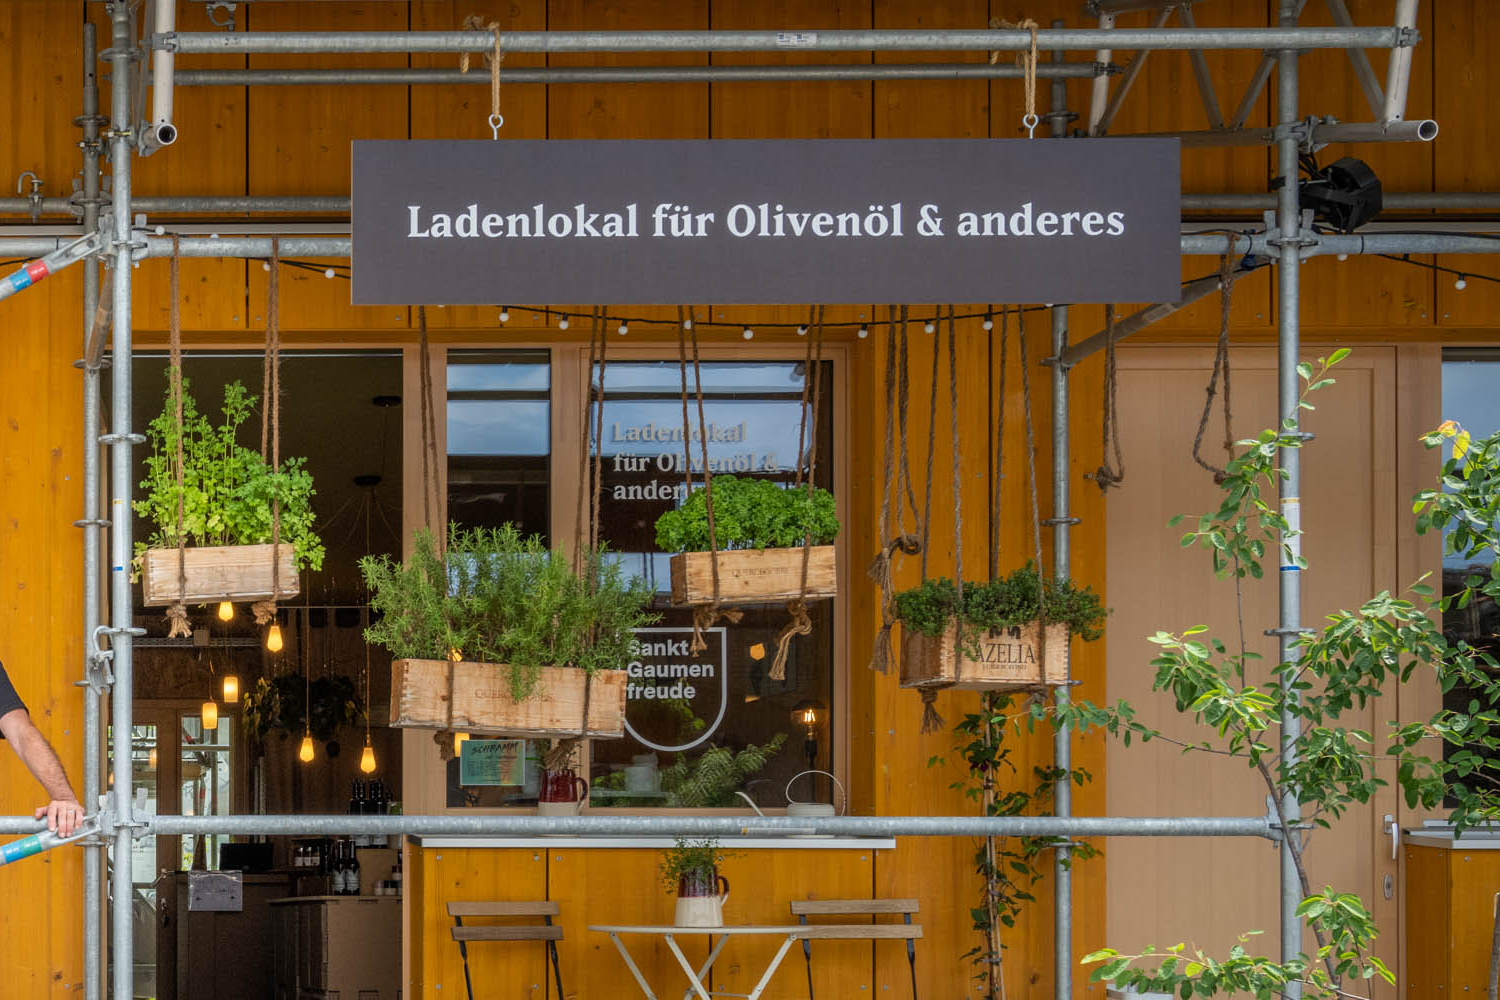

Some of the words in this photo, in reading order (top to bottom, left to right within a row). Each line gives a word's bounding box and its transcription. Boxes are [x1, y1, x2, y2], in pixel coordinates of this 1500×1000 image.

[407, 203, 639, 238] Ladenlokal
[652, 203, 715, 238] für
[726, 203, 904, 238] Olivenöl
[916, 203, 946, 238] &
[957, 202, 1125, 237] anderes
[613, 452, 651, 472] für
[626, 660, 715, 678] Gaumen
[626, 681, 696, 700] freude
